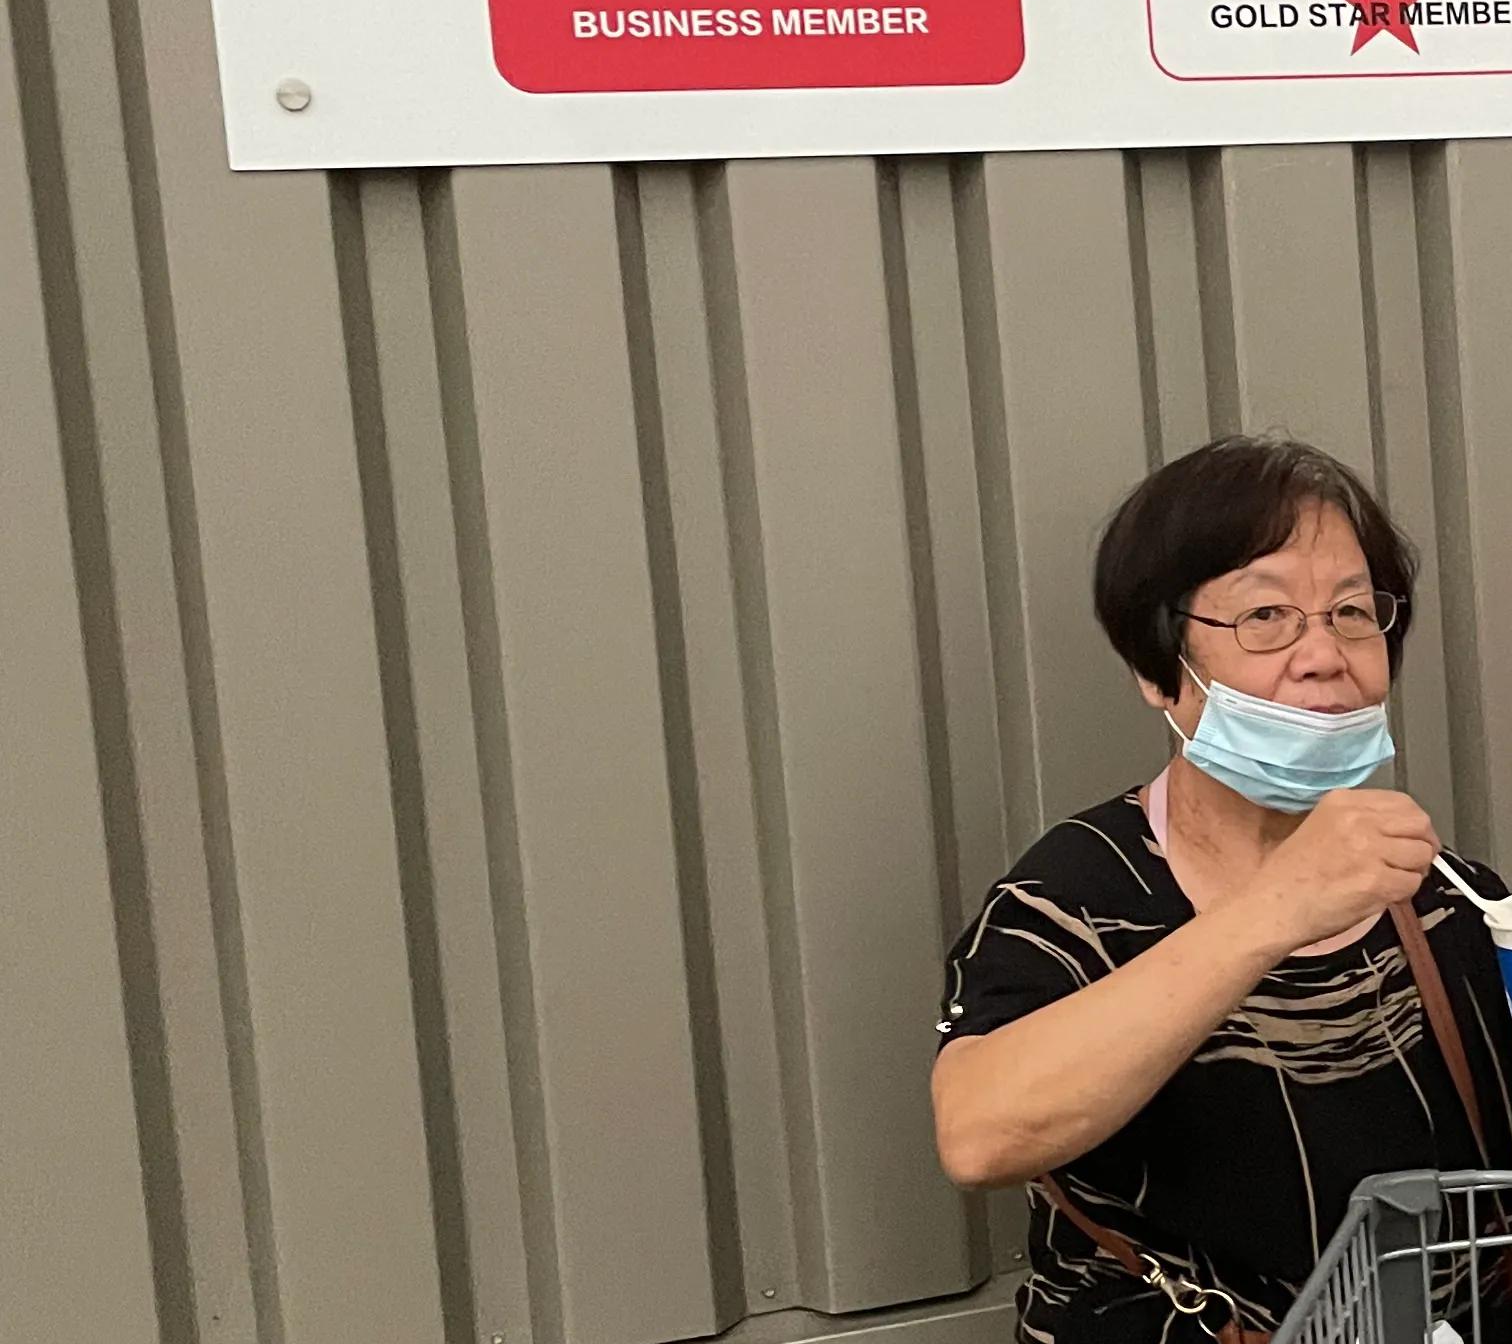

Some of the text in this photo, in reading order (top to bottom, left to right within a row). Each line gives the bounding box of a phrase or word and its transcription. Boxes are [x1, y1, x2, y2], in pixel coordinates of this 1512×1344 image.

[572, 7, 930, 38] BUSINESS MEMBER
[1210, 4, 1299, 29] GOLD
[1308, 1, 1391, 27] STAR
